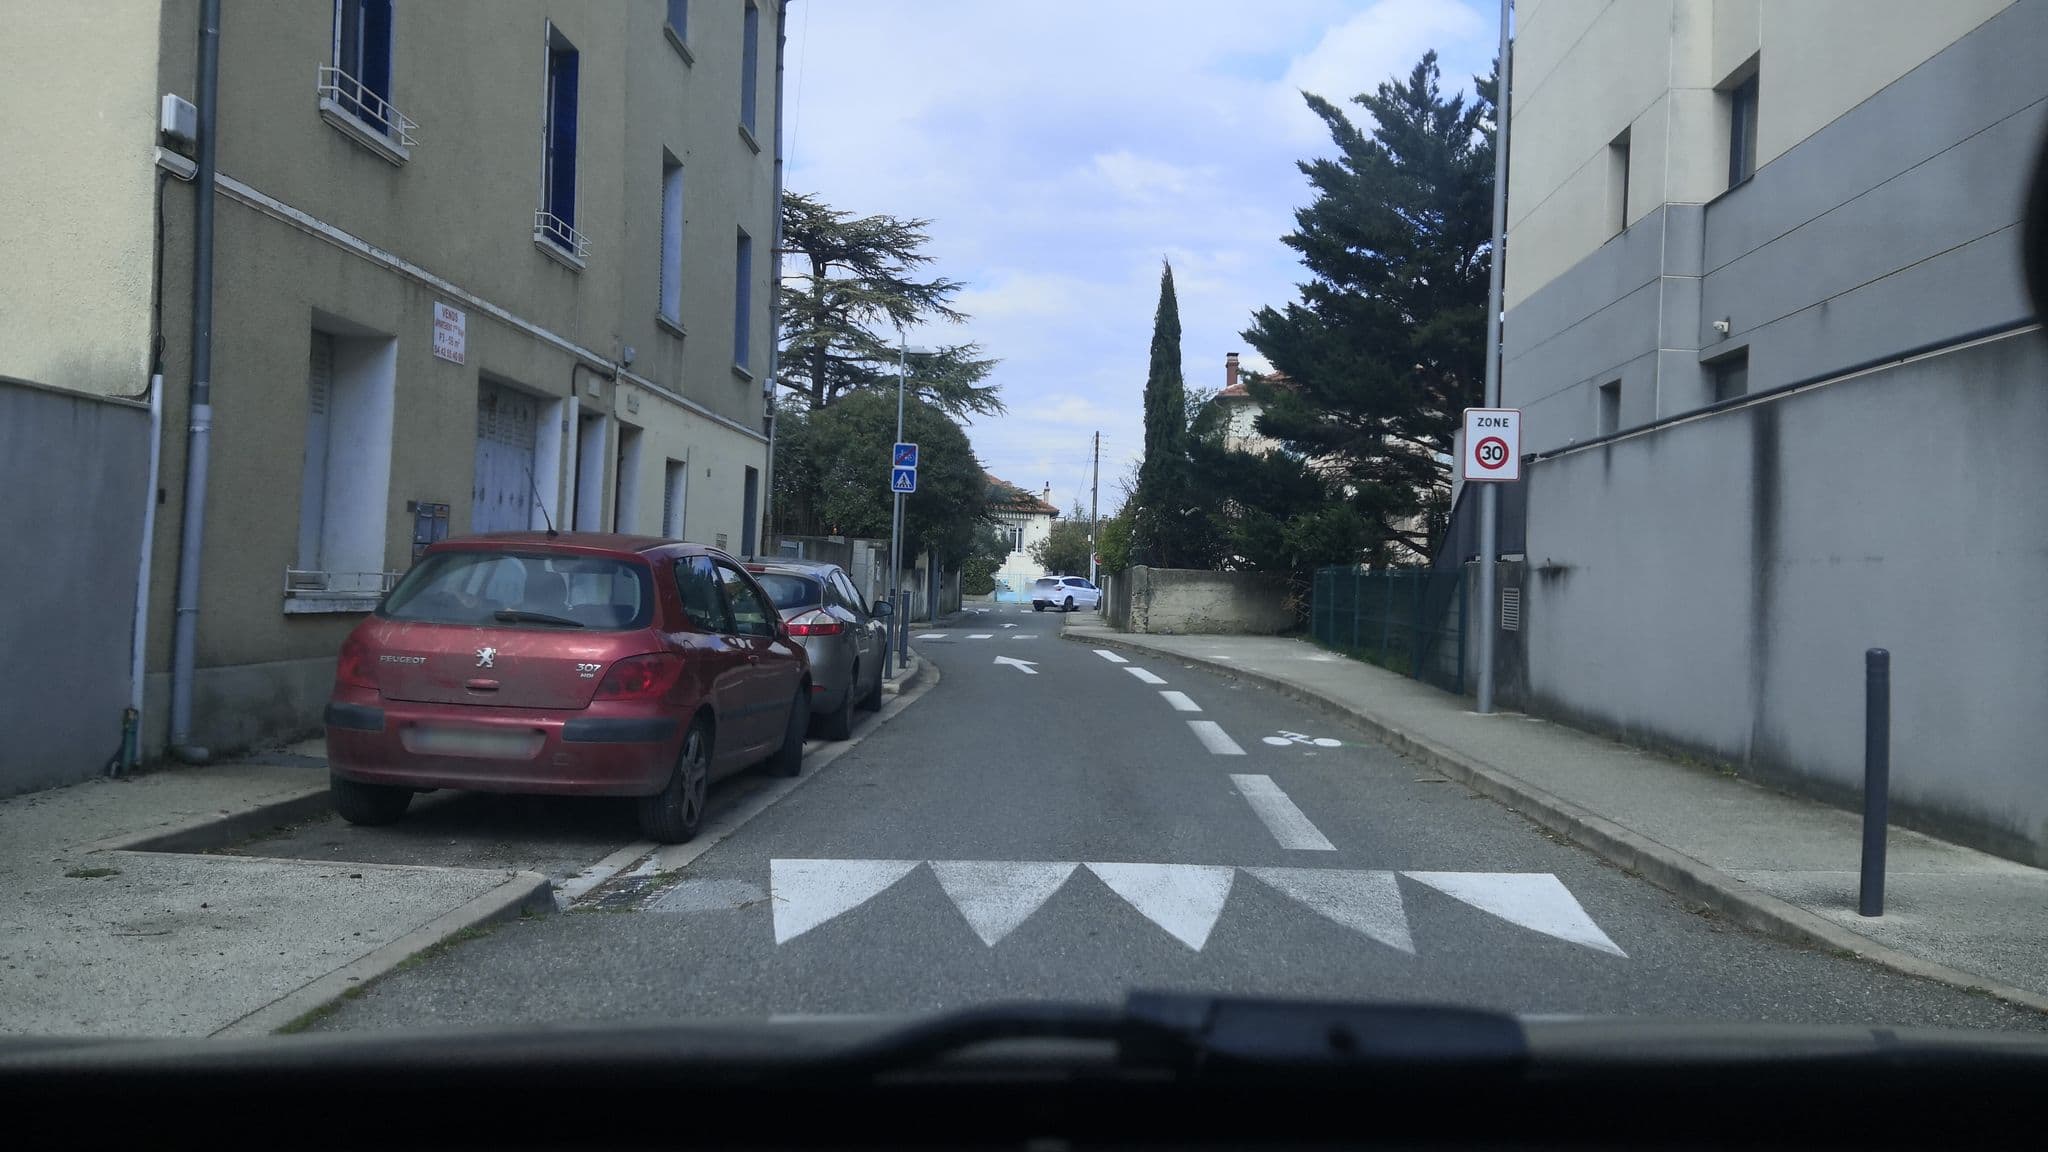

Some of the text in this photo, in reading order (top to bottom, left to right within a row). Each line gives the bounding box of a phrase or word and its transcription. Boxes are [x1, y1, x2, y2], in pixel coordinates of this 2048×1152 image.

[1477, 417, 1509, 427] ZONE
[1482, 445, 1503, 460] 30
[380, 655, 427, 664] PEUGEOT
[575, 663, 602, 672] 307
